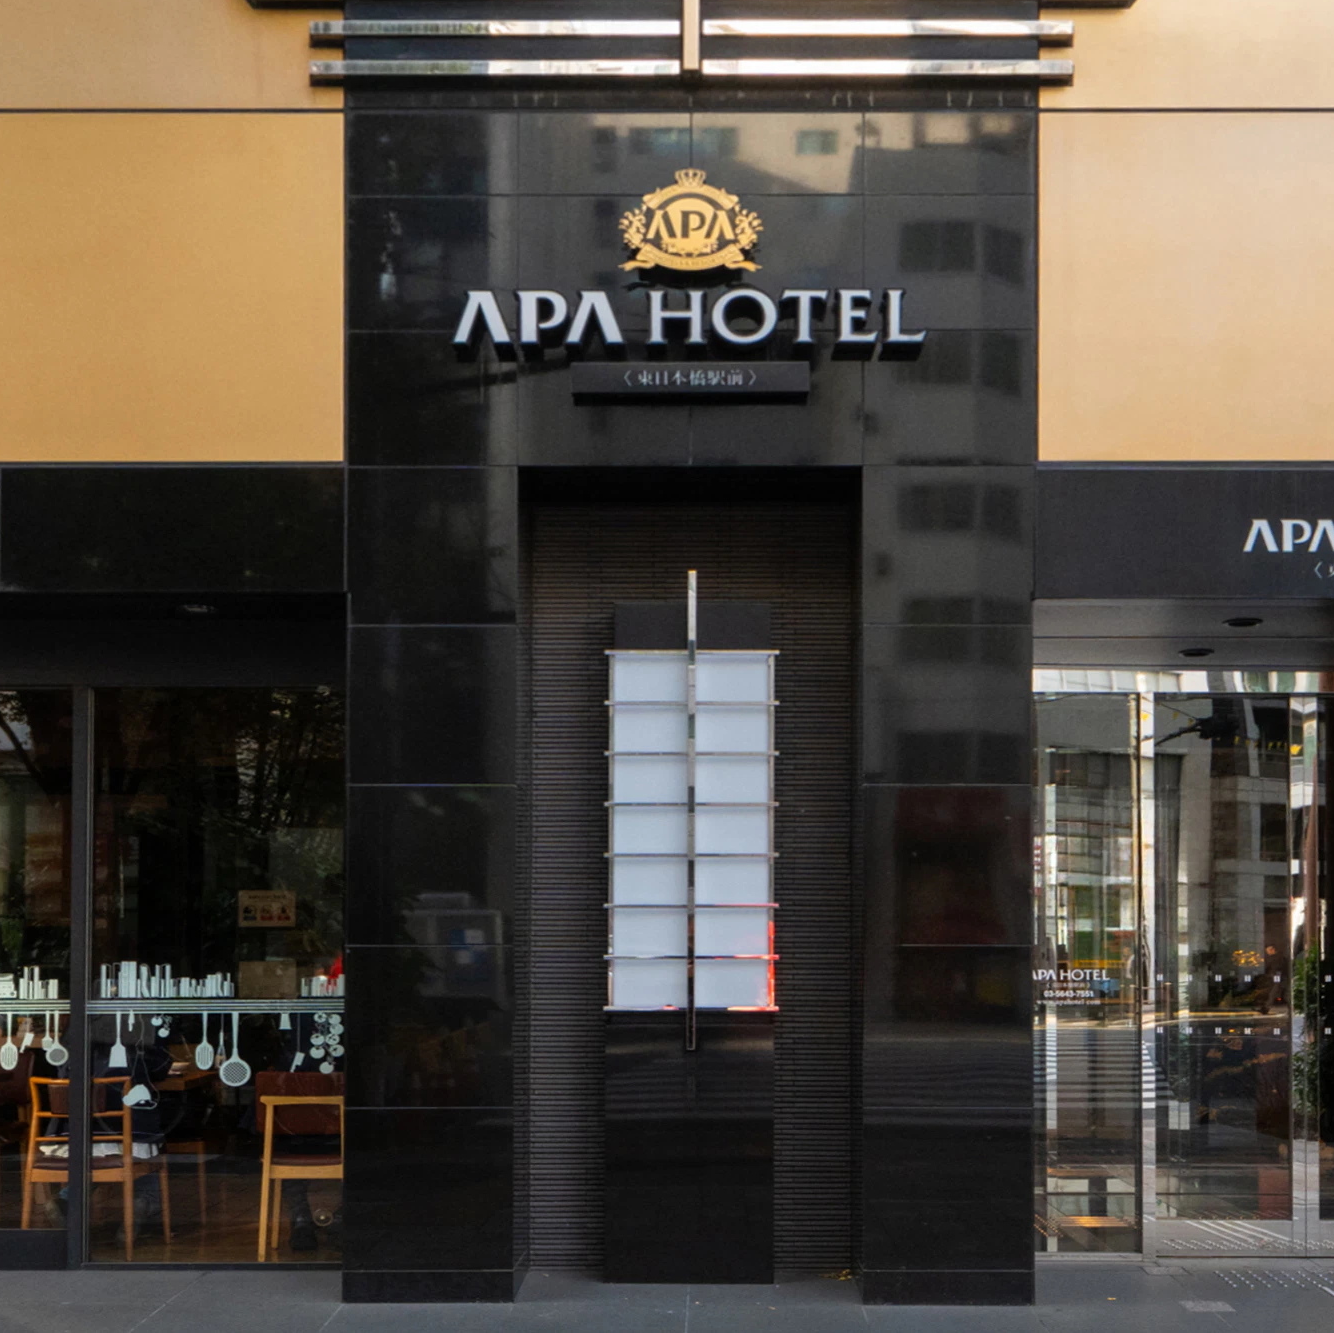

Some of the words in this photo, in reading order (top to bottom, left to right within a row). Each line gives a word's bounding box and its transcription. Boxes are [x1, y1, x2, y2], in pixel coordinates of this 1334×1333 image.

[646, 209, 736, 240] APA
[452, 289, 626, 352] APA
[648, 288, 928, 352] HOTEL
[1059, 968, 1111, 981] HOTEL
